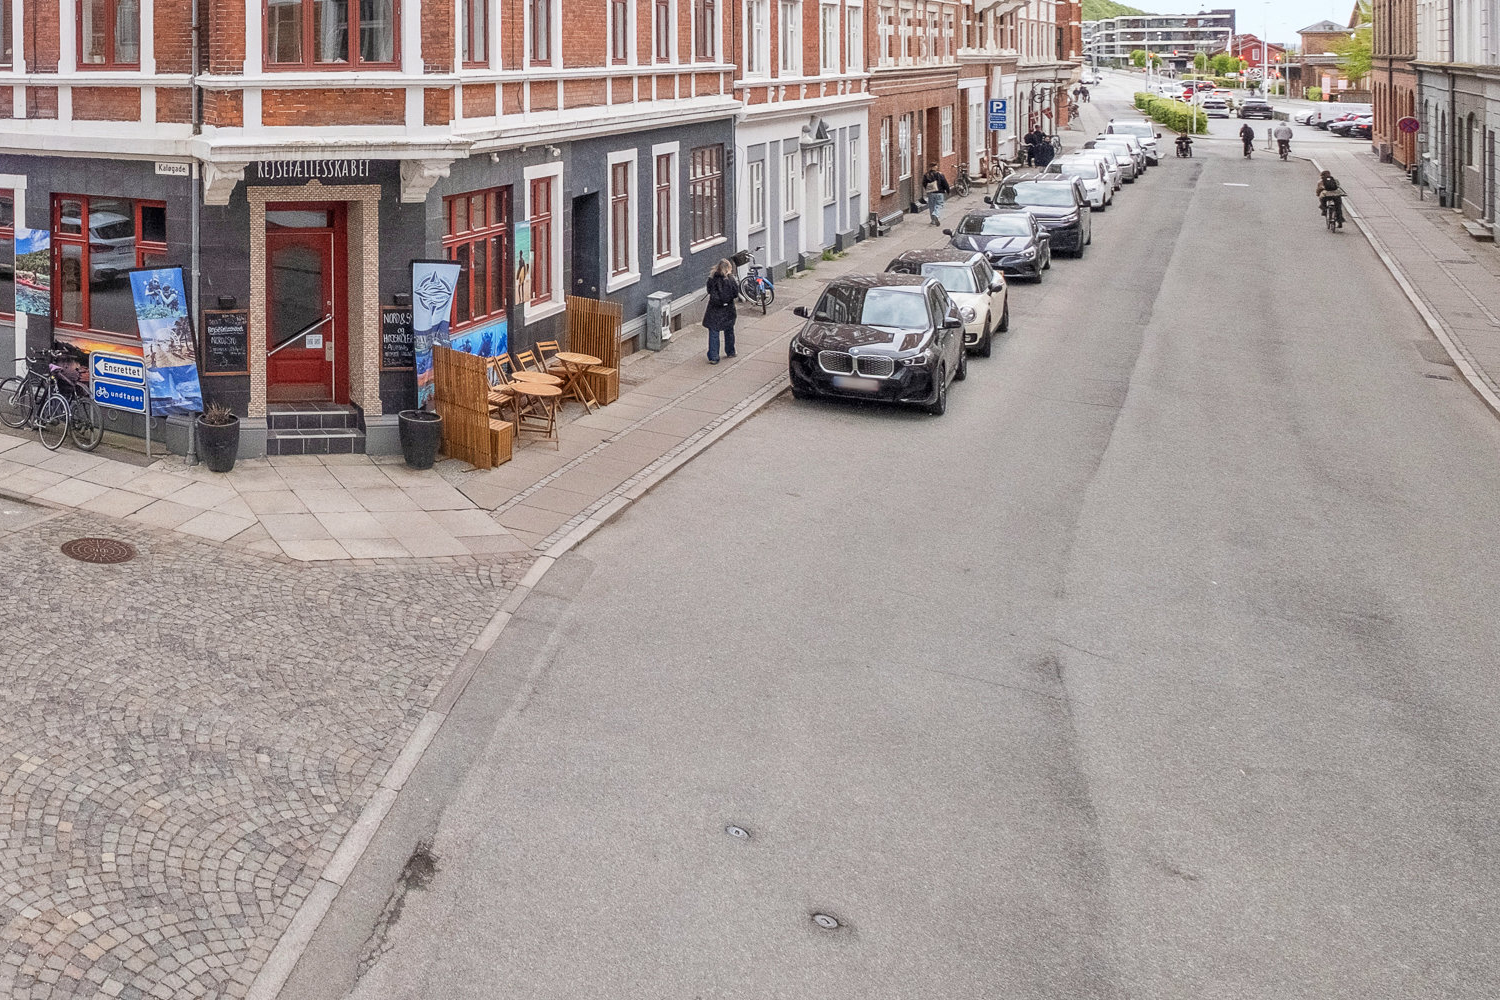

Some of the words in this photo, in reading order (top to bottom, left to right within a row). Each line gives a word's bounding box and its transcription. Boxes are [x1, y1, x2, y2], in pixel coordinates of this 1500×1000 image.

[992, 101, 1003, 113] P
[158, 164, 186, 174] Kaløgade
[257, 159, 371, 180] REJSEFÆLLESSKABET
[103, 362, 141, 377] Ensrettet
[110, 391, 143, 403] undtaget
